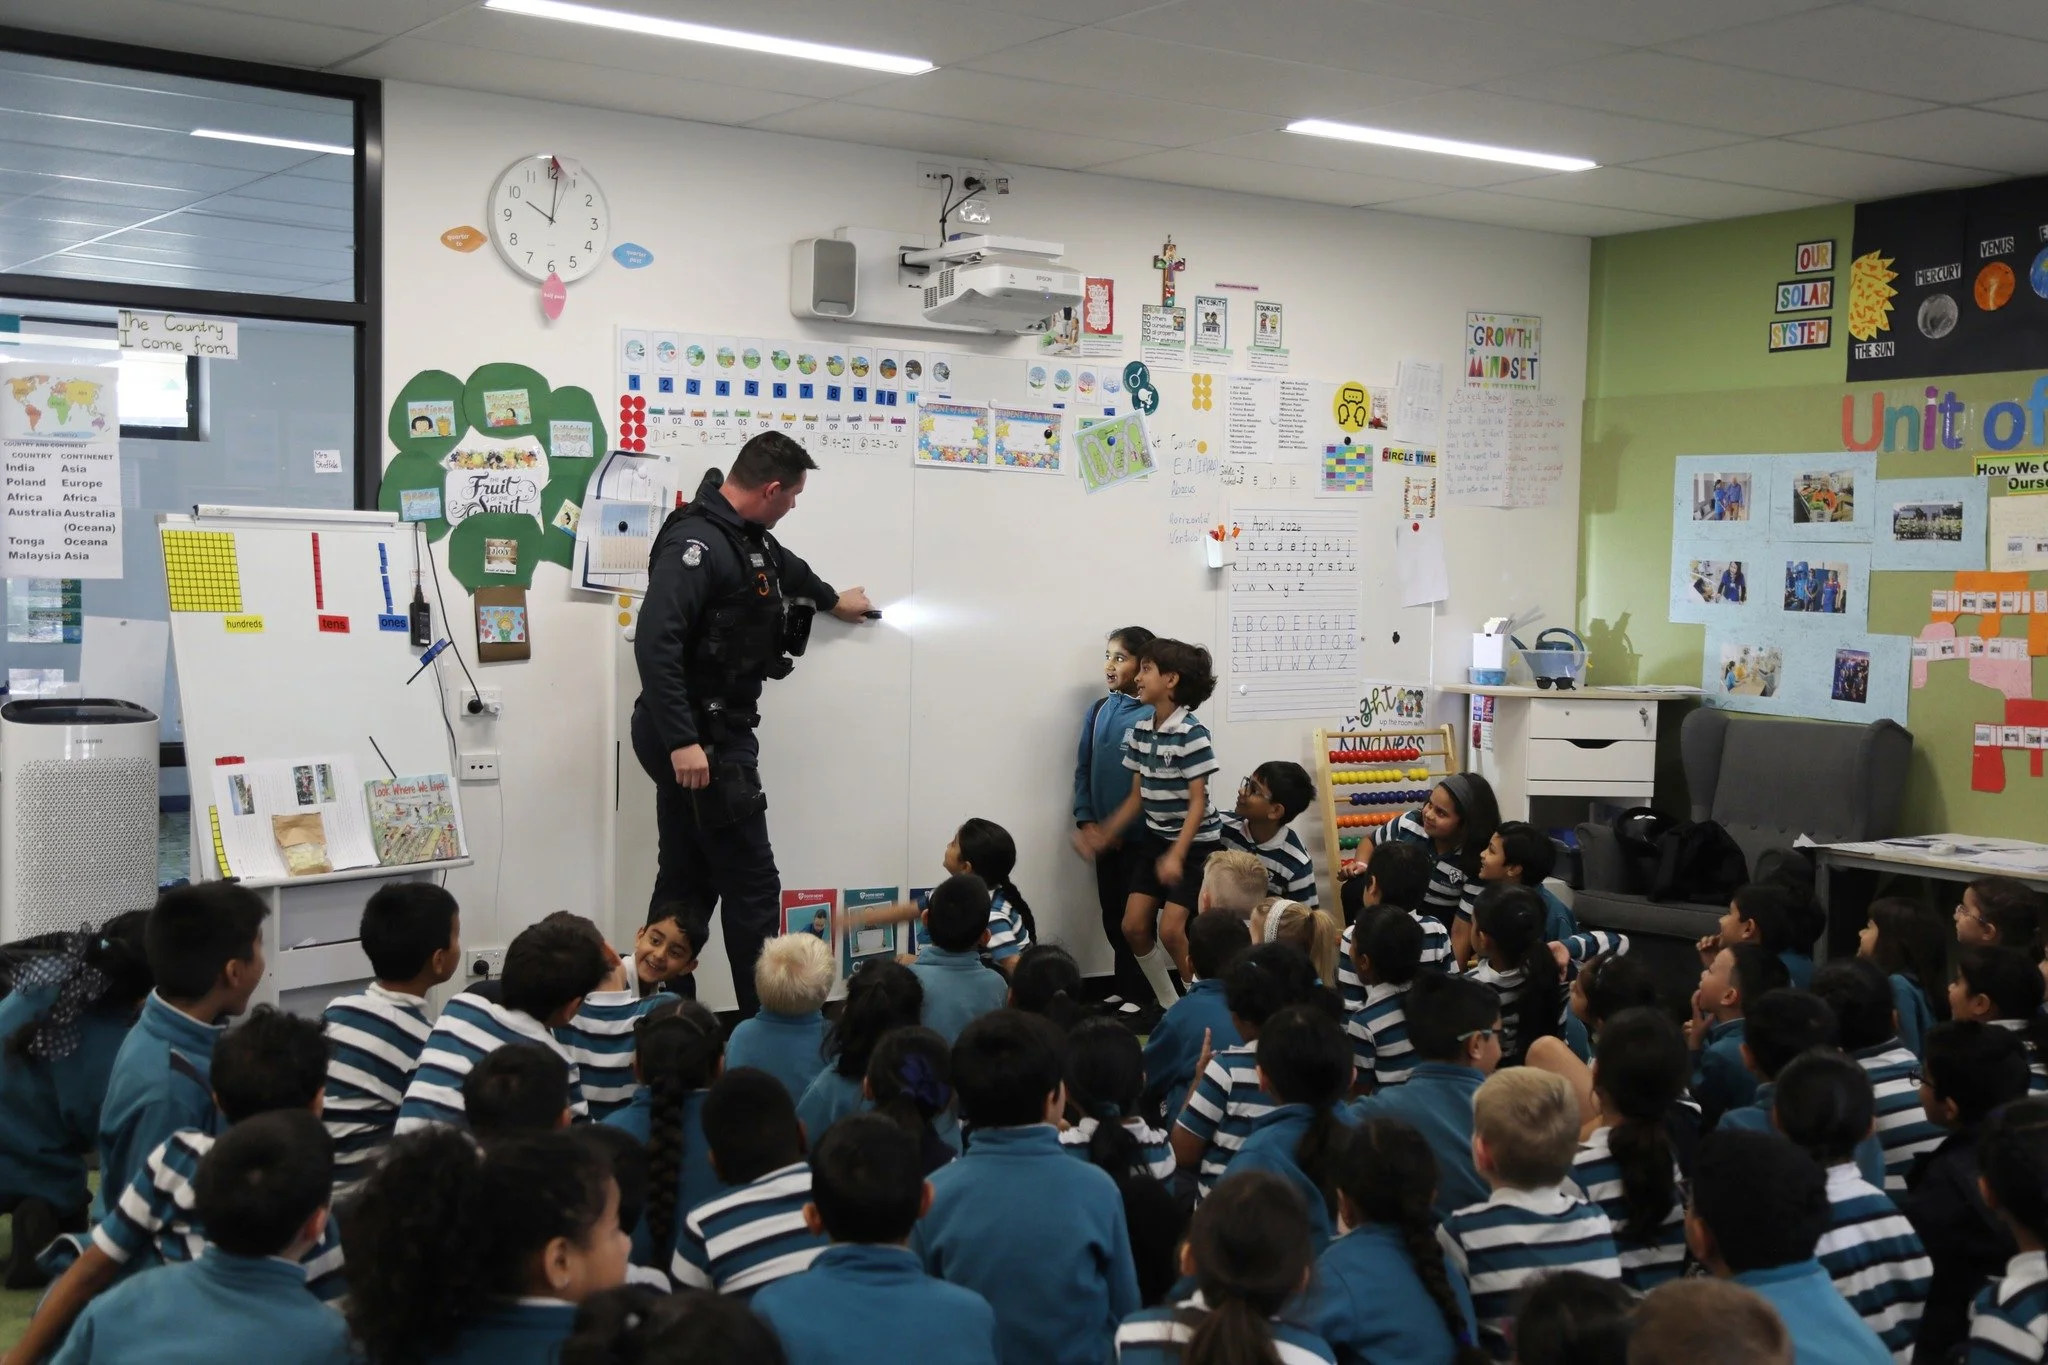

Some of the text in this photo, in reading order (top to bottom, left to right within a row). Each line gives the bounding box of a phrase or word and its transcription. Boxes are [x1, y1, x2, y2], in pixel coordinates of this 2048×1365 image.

[526, 170, 536, 184] 11
[547, 166, 558, 180] 12
[509, 186, 521, 199] 10
[585, 194, 593, 207] 2
[503, 209, 512, 221] 9
[590, 218, 599, 231] 3
[509, 233, 518, 246] 8
[584, 241, 593, 253] 4
[1981, 238, 2014, 257] VENUS
[526, 252, 534, 264] 7
[569, 256, 577, 268] 5
[1800, 244, 1828, 270] OUR
[547, 260, 556, 272] 6
[1916, 264, 1960, 286] MERCURY
[1781, 283, 1829, 309] SOLAR
[1257, 304, 1280, 313] COURAGE
[119, 310, 224, 341] The Country
[120, 330, 134, 347] I
[142, 338, 183, 351] come
[1474, 326, 1532, 349] GROWTH
[1772, 321, 1828, 348] SYSTEM
[1856, 343, 1894, 359] THE SUN
[632, 378, 637, 388] 1
[662, 380, 669, 391] 2
[690, 382, 696, 392] 3
[720, 383, 726, 394] 4
[748, 383, 755, 394] 5
[776, 386, 782, 396] 6
[803, 386, 809, 397] 7
[831, 388, 837, 399] 8
[858, 388, 864, 400] 9
[652, 416, 660, 424] 01
[1842, 376, 2048, 452] Unit of
[1382, 451, 1436, 463] CIRCLE TIME
[6, 463, 87, 473] India Asia
[1977, 464, 2010, 476] How
[2015, 462, 2039, 474] We
[6, 478, 103, 489] Poland Europe
[465, 472, 523, 500] Fruit
[7, 493, 98, 502] Africa Africa
[8, 508, 116, 518] Australia Australia
[64, 524, 116, 534] (Oceana)
[1252, 516, 1274, 537] April
[8, 537, 108, 547] Tonga Oceana
[8, 552, 90, 562] Malaysia Asia
[490, 548, 510, 556] JOY
[226, 619, 262, 628] hundreds
[322, 618, 346, 630] tens
[381, 618, 407, 628] ones
[374, 784, 390, 797] Look
[392, 783, 416, 795] Where
[417, 781, 428, 793] We
[430, 778, 446, 792] Live!
